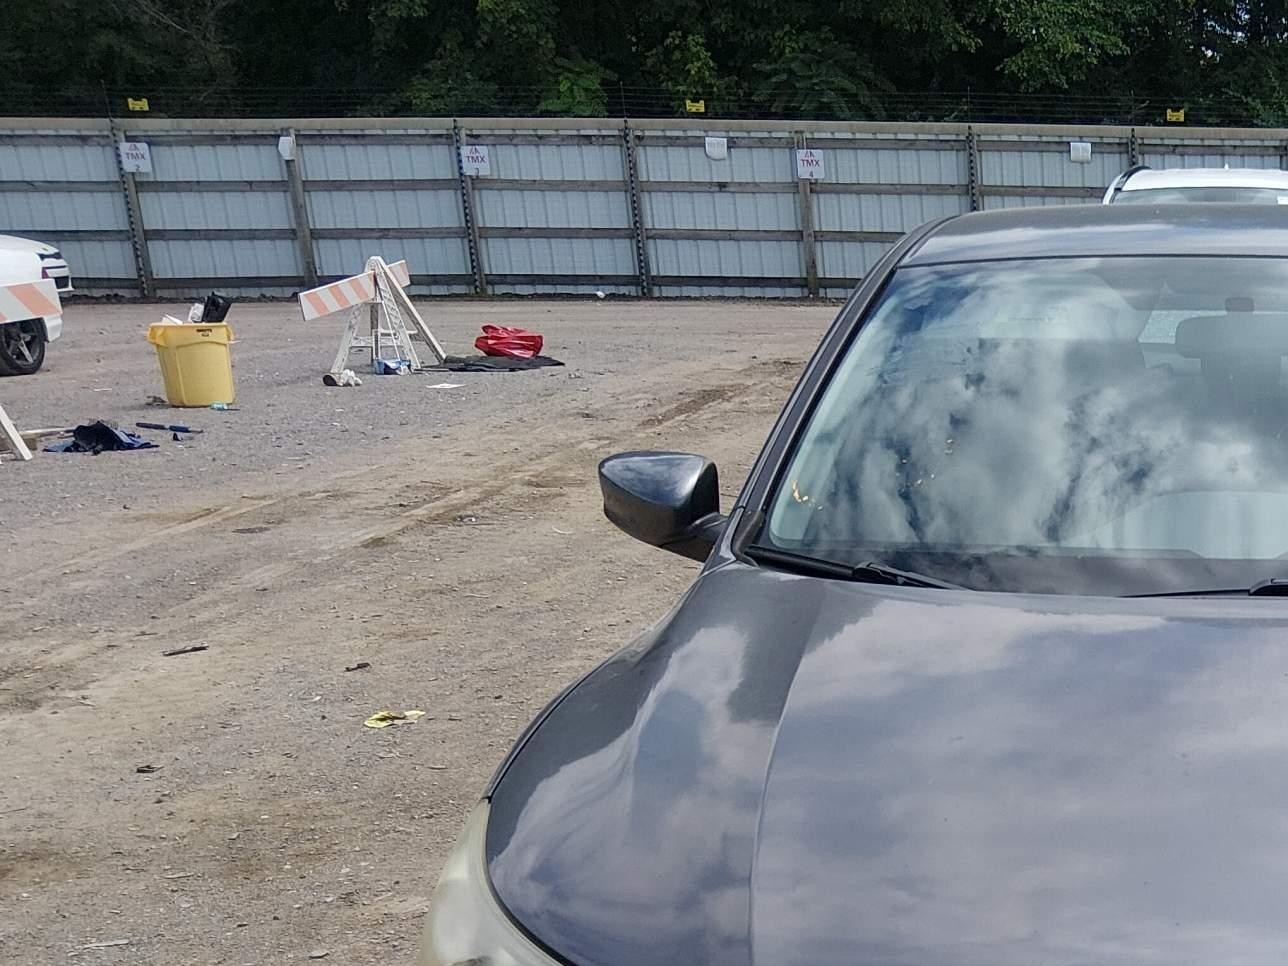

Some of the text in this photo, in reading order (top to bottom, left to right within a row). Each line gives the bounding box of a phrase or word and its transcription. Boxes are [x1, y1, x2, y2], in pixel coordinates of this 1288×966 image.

[125, 152, 145, 161] TMX
[466, 155, 486, 164] TMX
[801, 159, 820, 167] TMX
